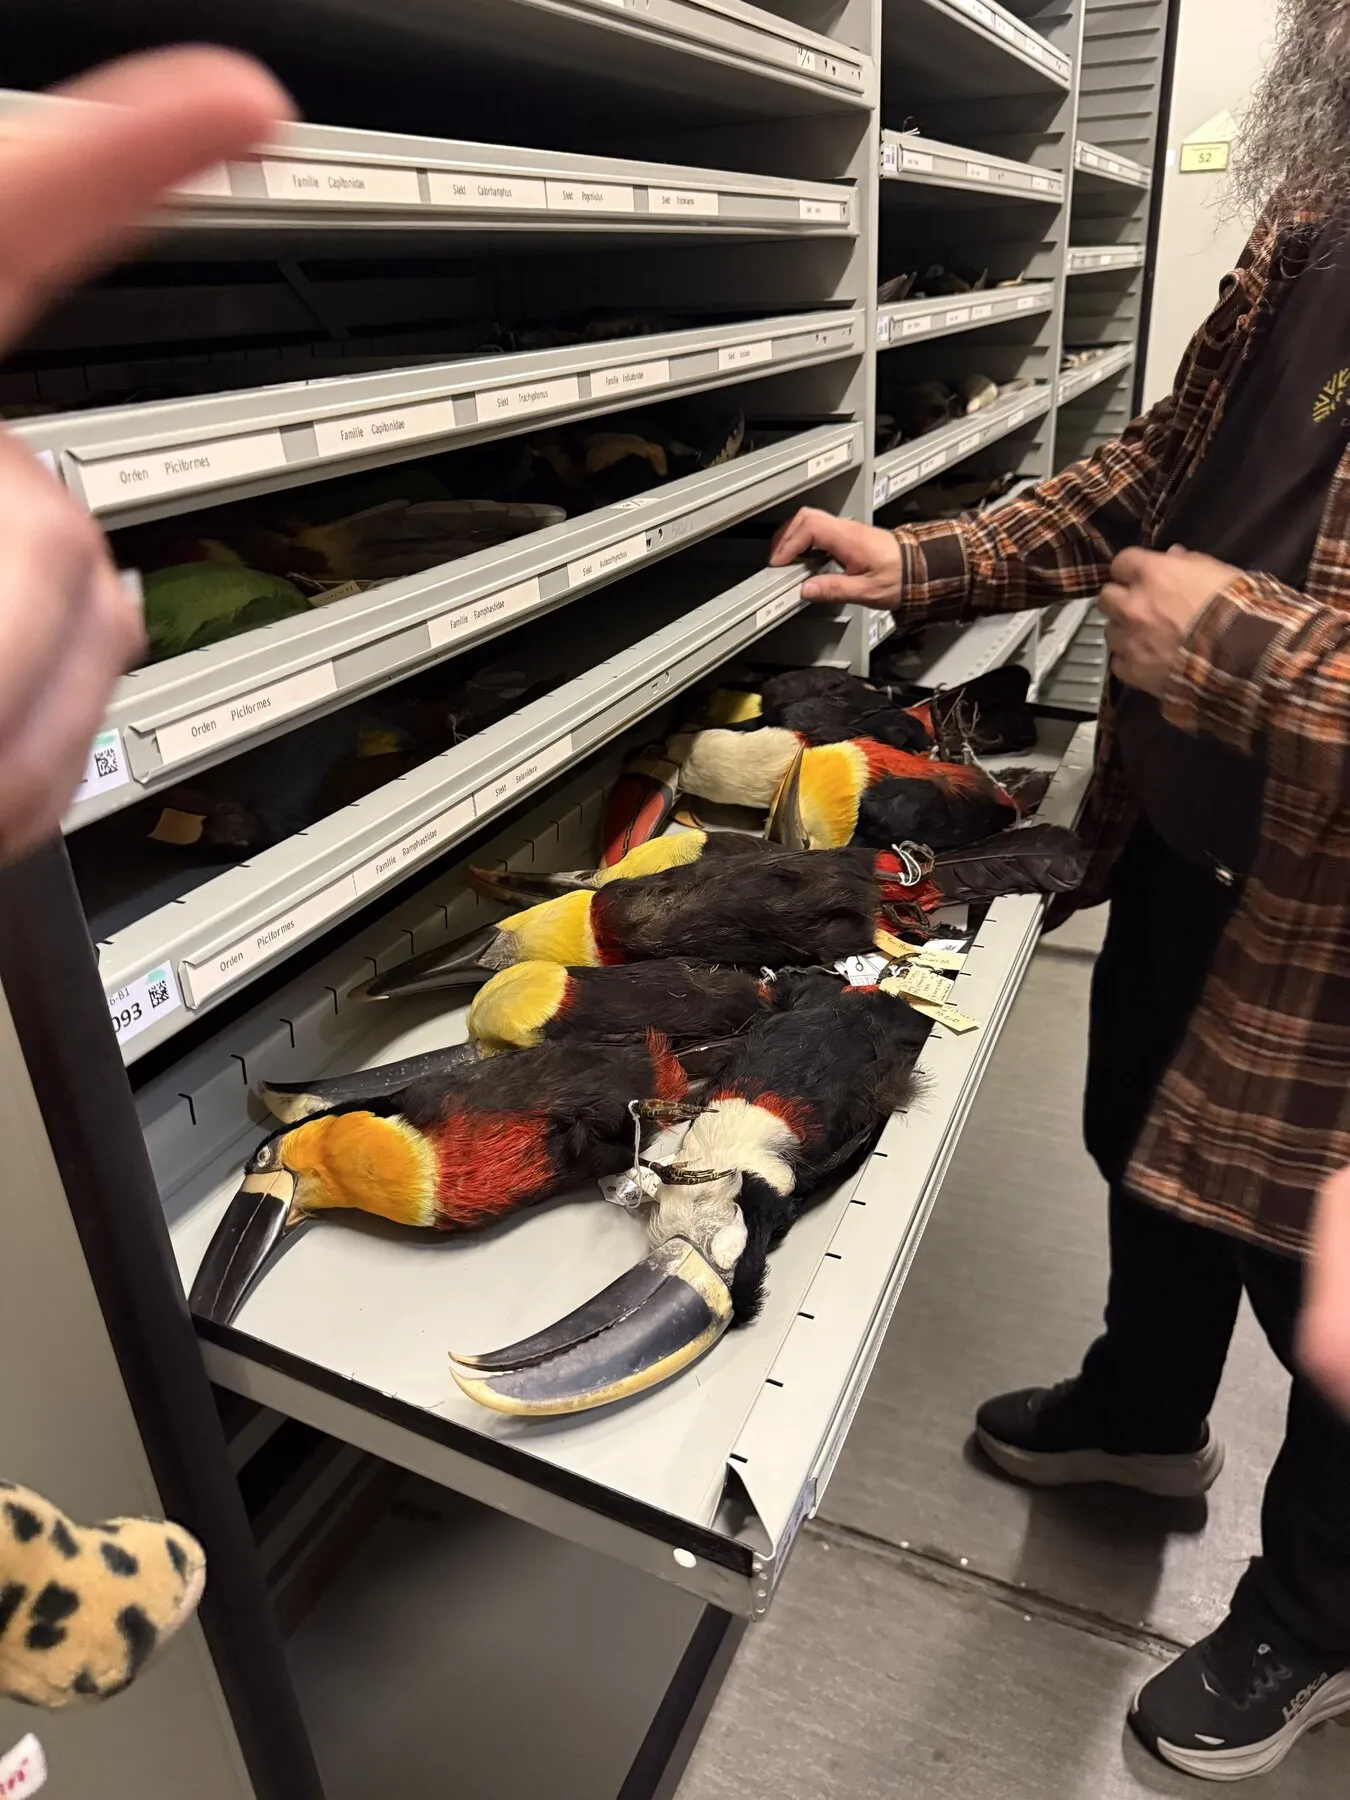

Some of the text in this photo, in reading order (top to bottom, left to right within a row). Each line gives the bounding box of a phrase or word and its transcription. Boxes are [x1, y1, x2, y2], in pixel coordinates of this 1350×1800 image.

[292, 174, 319, 188] Familie
[340, 420, 405, 441] Familie Capitonidae
[120, 457, 211, 485] Orden Piciformes
[449, 600, 505, 630] Familie Ramphastidae
[191, 697, 272, 738] Orden Piciformes
[375, 829, 438, 875] Familie Ramphastidae
[219, 919, 295, 973] Orden Piciformes
